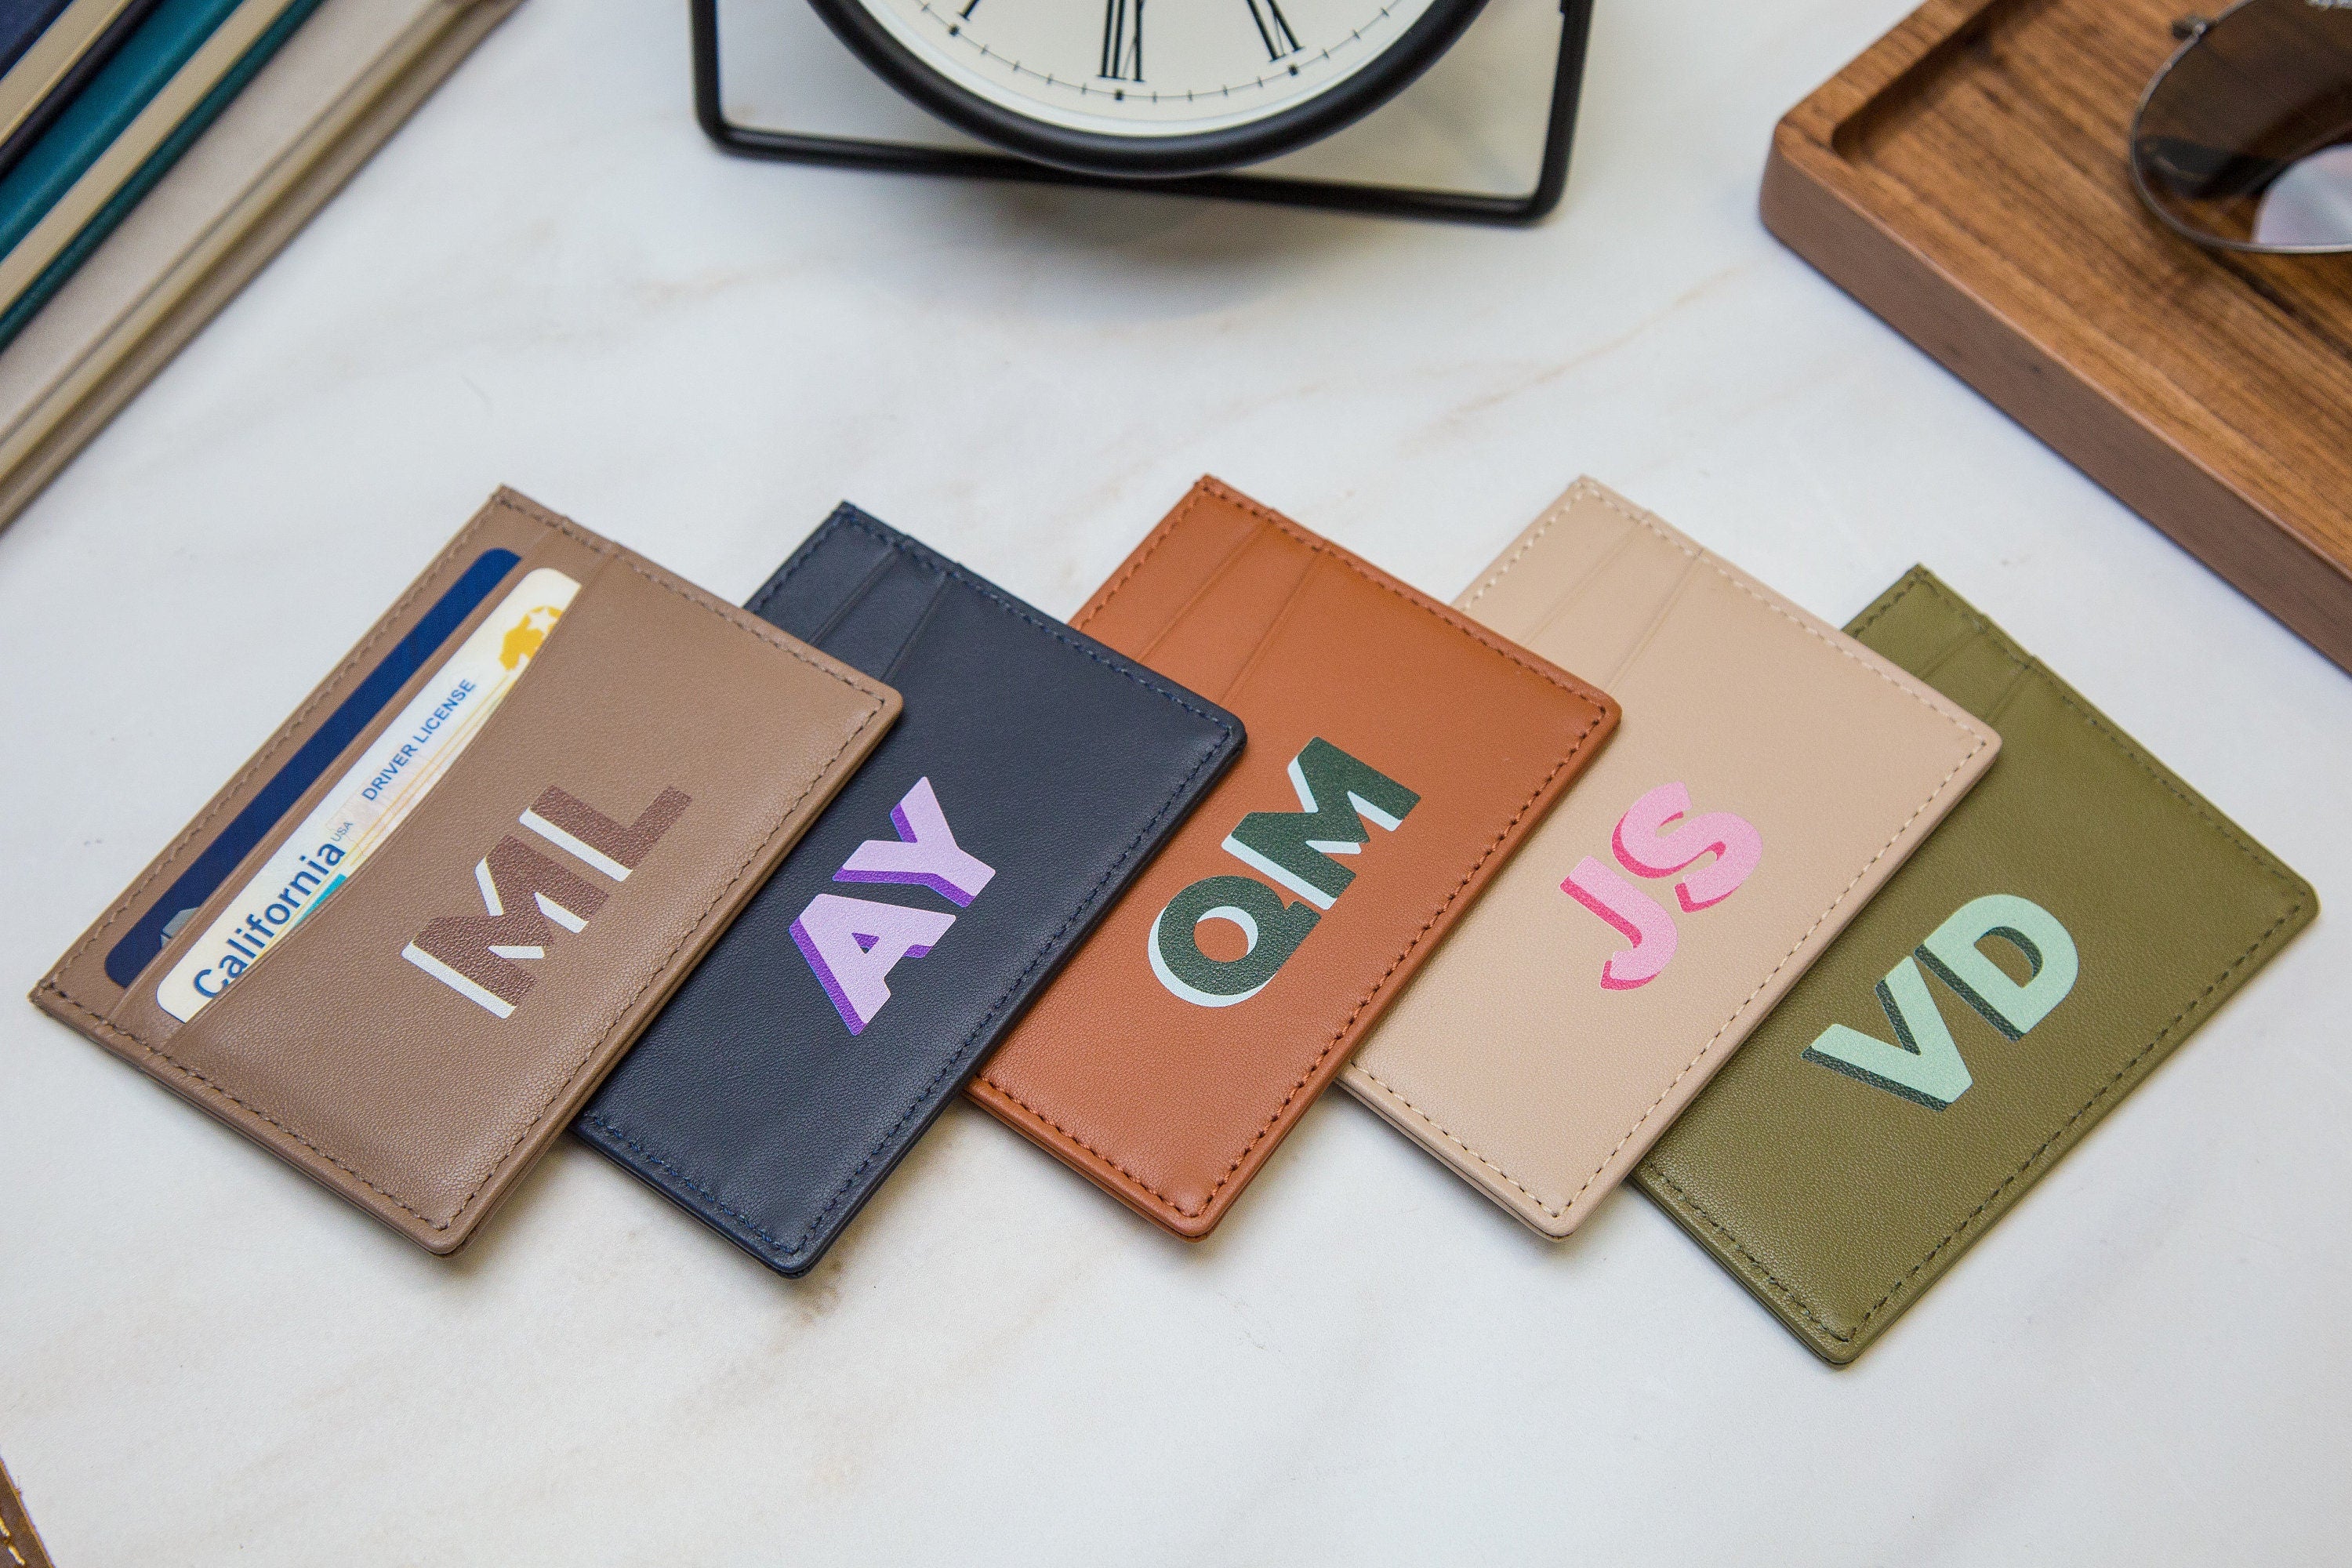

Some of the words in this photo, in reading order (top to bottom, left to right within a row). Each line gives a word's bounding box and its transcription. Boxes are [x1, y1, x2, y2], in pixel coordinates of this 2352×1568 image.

[361, 743, 418, 801] DRIVER
[412, 679, 477, 743] LICENSE
[194, 843, 347, 998] California
[330, 820, 354, 842] USA
[401, 785, 692, 1019] ML
[789, 776, 996, 1036] AY
[1148, 736, 1421, 1008] QM
[1559, 781, 1763, 991] JS
[1800, 894, 2078, 1112] VD
